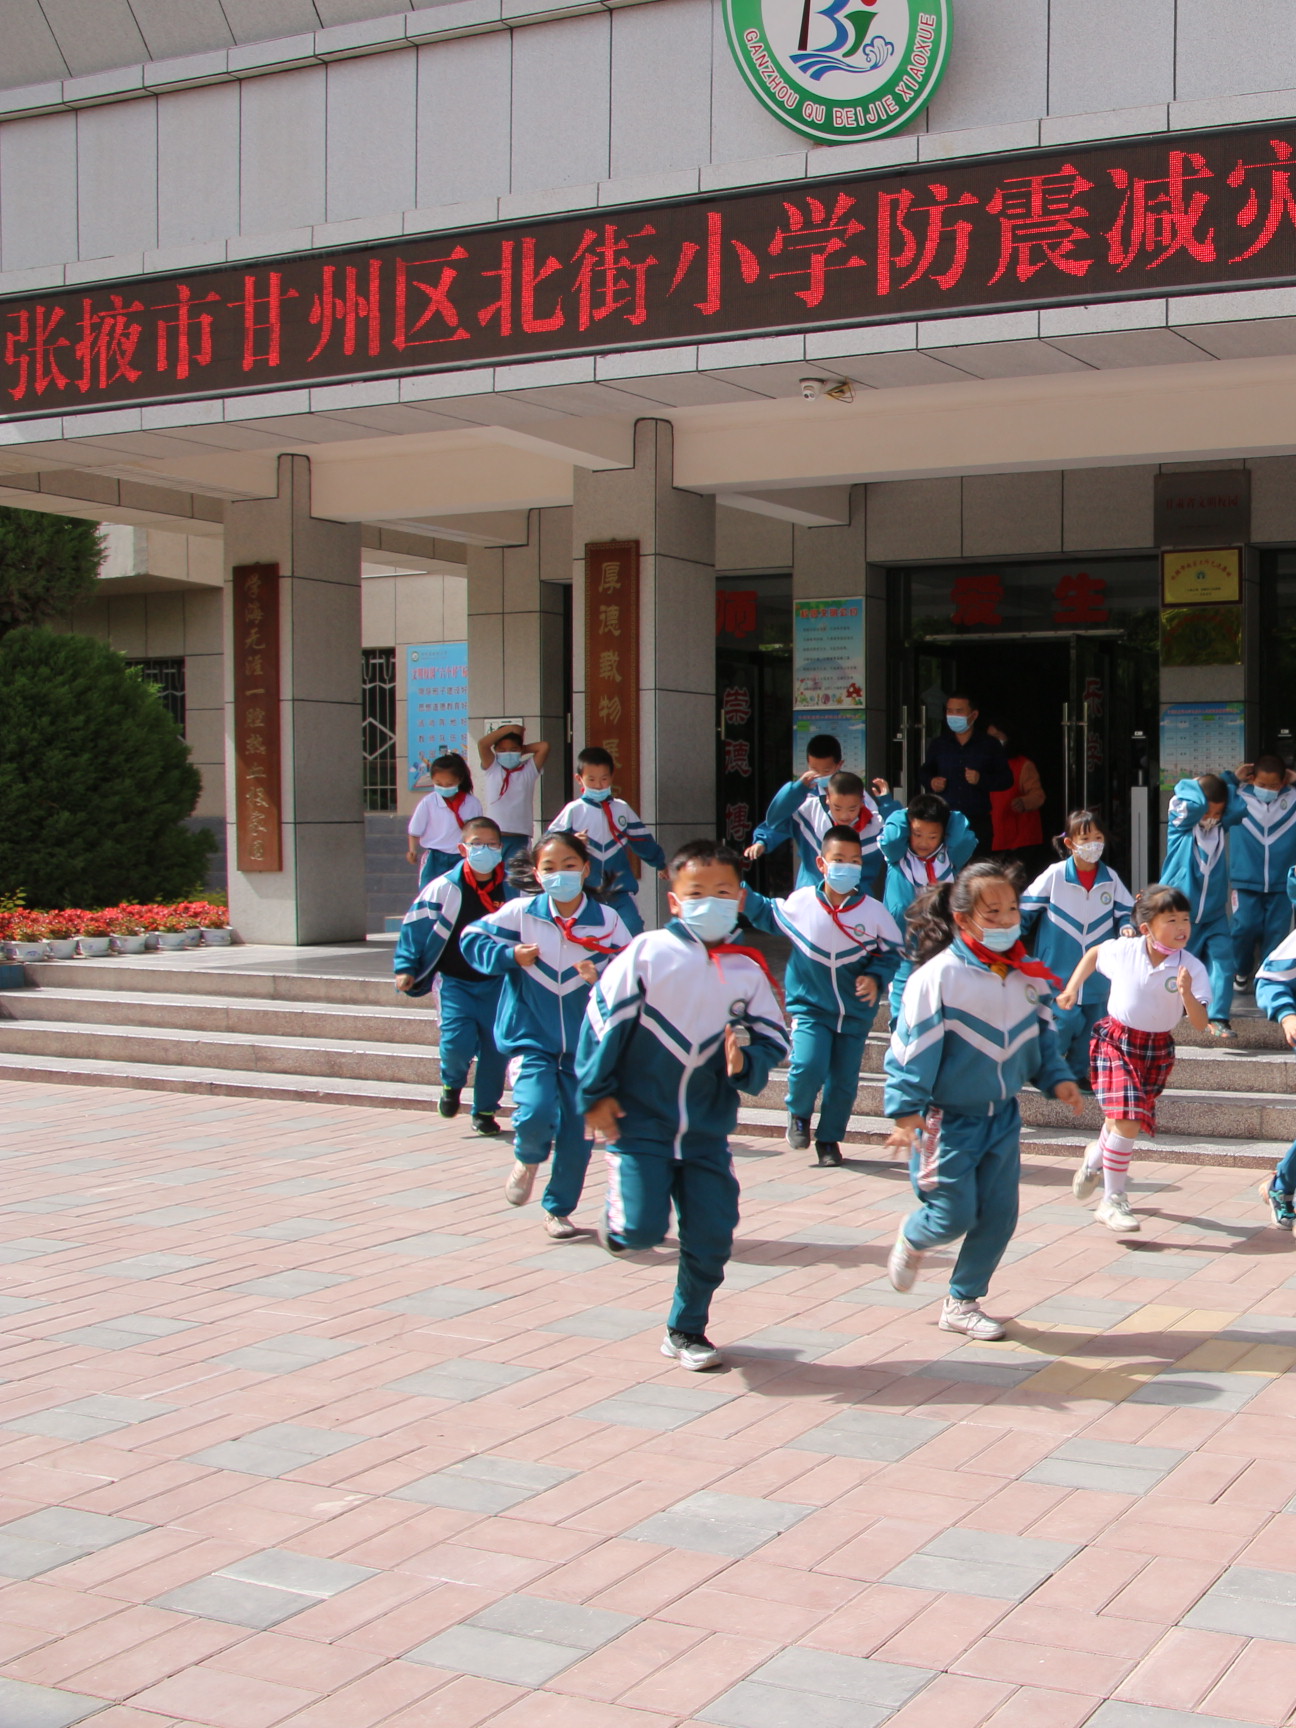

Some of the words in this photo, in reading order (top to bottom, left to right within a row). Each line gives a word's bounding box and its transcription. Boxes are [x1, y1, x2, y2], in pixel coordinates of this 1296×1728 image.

[743, 28, 799, 109] GANZHOU
[803, 101, 825, 124] QU
[833, 96, 899, 128] BEIJIE
[895, 13, 936, 103] XIAOXUE
[950, 572, 1109, 625] 爱生
[722, 686, 753, 871] 崇德博
